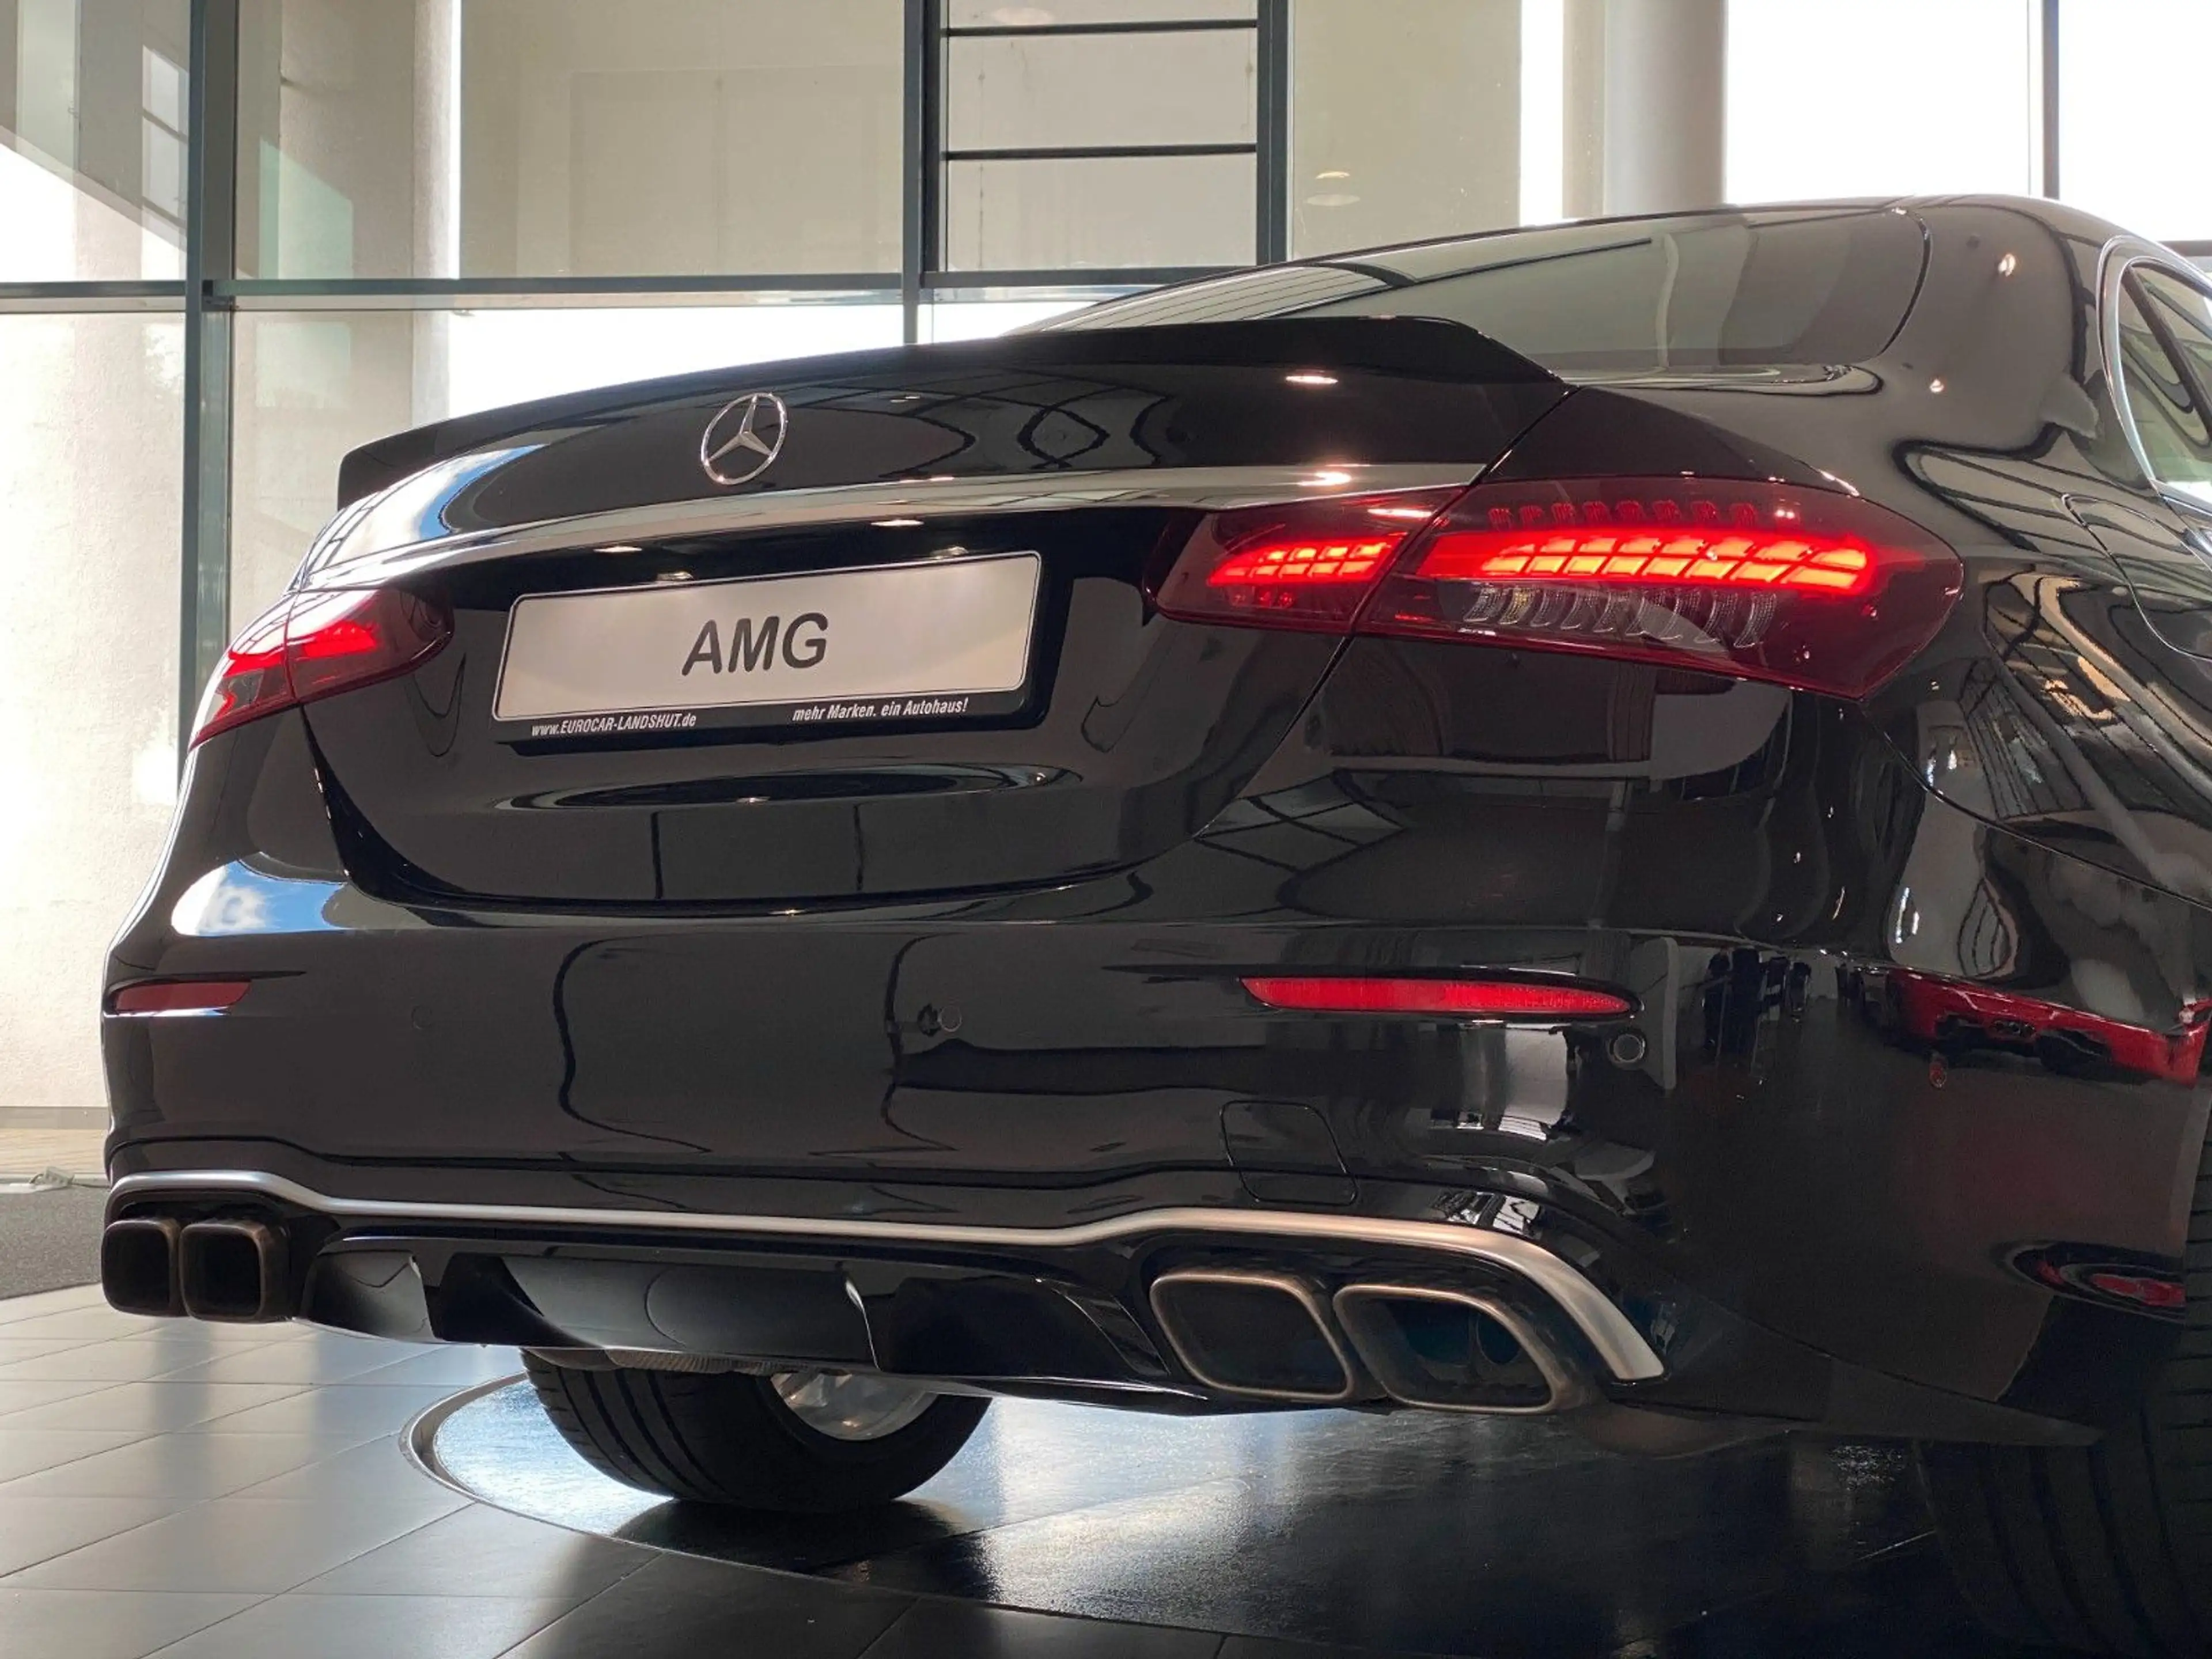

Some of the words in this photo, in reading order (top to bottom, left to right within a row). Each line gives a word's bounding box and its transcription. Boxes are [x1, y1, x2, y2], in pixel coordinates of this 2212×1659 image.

[681, 612, 830, 676] AMG
[792, 706, 825, 721] mehr
[827, 704, 876, 719] Marken.
[881, 701, 901, 717] ein
[903, 697, 969, 715] Autohaus!
[532, 713, 697, 737] www.EUROCAR-LANDSHUT.de
